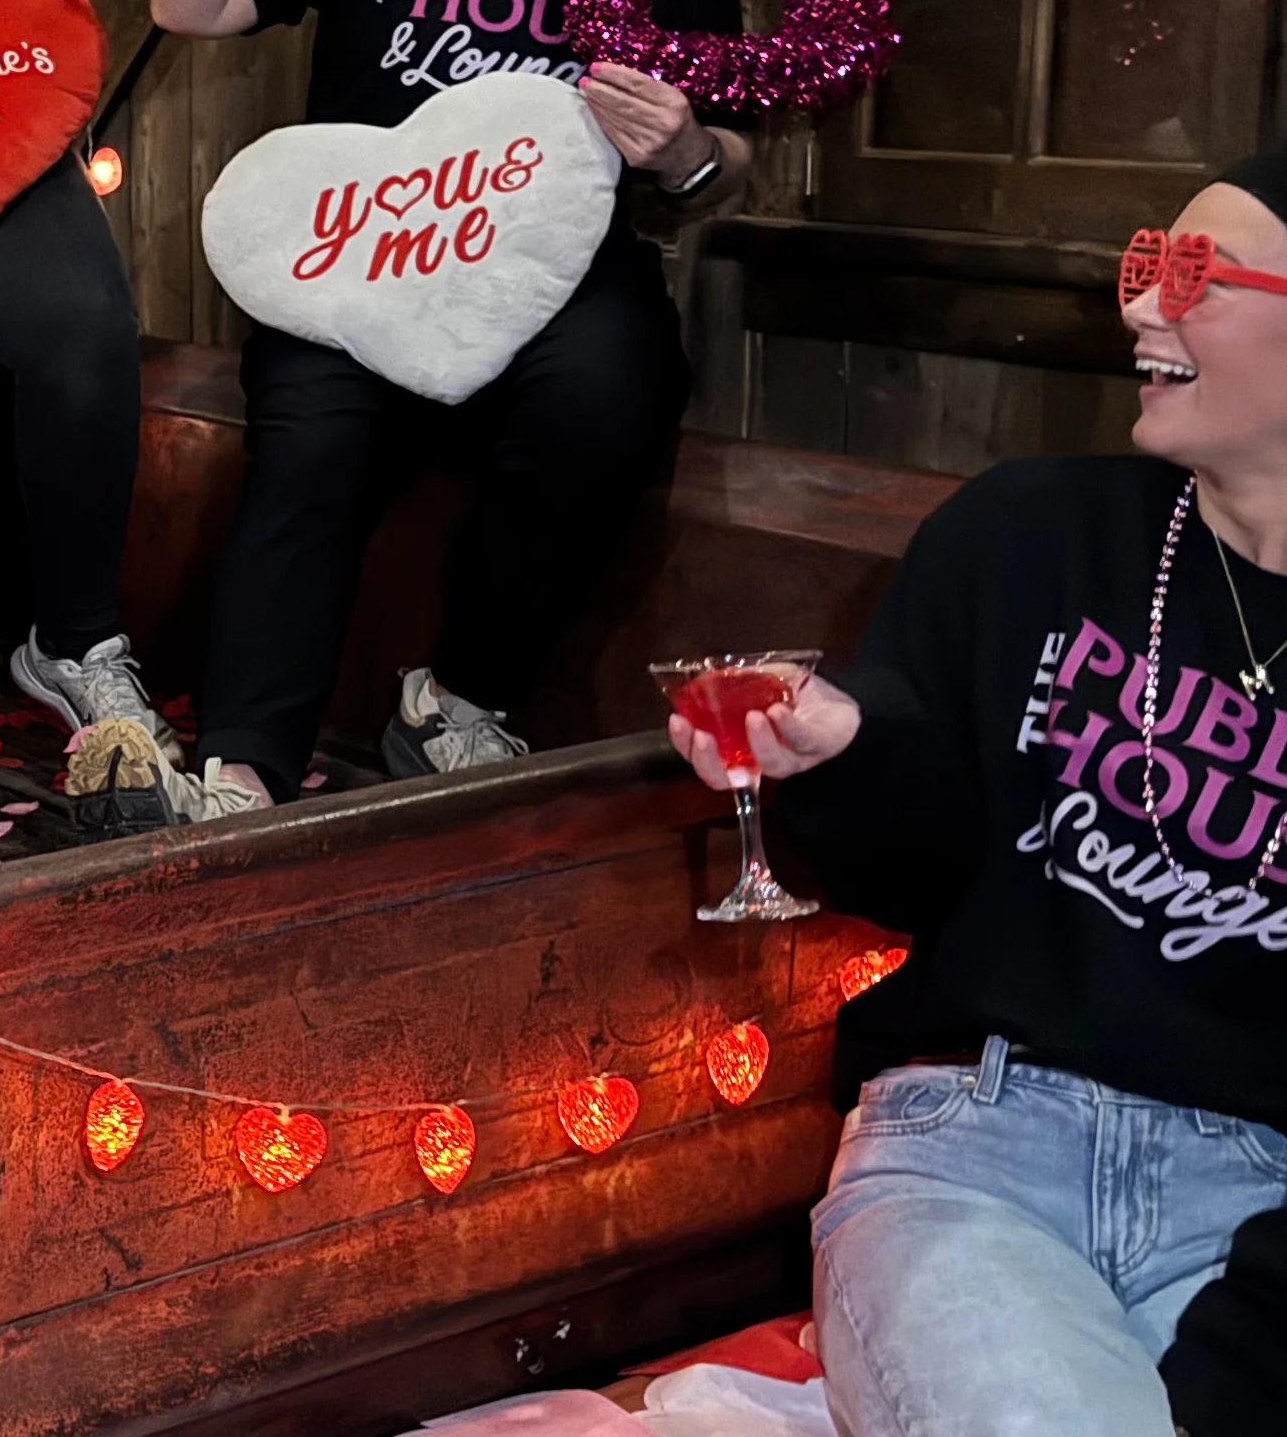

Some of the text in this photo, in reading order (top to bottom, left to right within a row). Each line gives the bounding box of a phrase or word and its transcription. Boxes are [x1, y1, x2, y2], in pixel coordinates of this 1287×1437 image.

[380, 21, 417, 70] &
[365, 206, 496, 282] me
[1047, 699, 1287, 885] HOU
